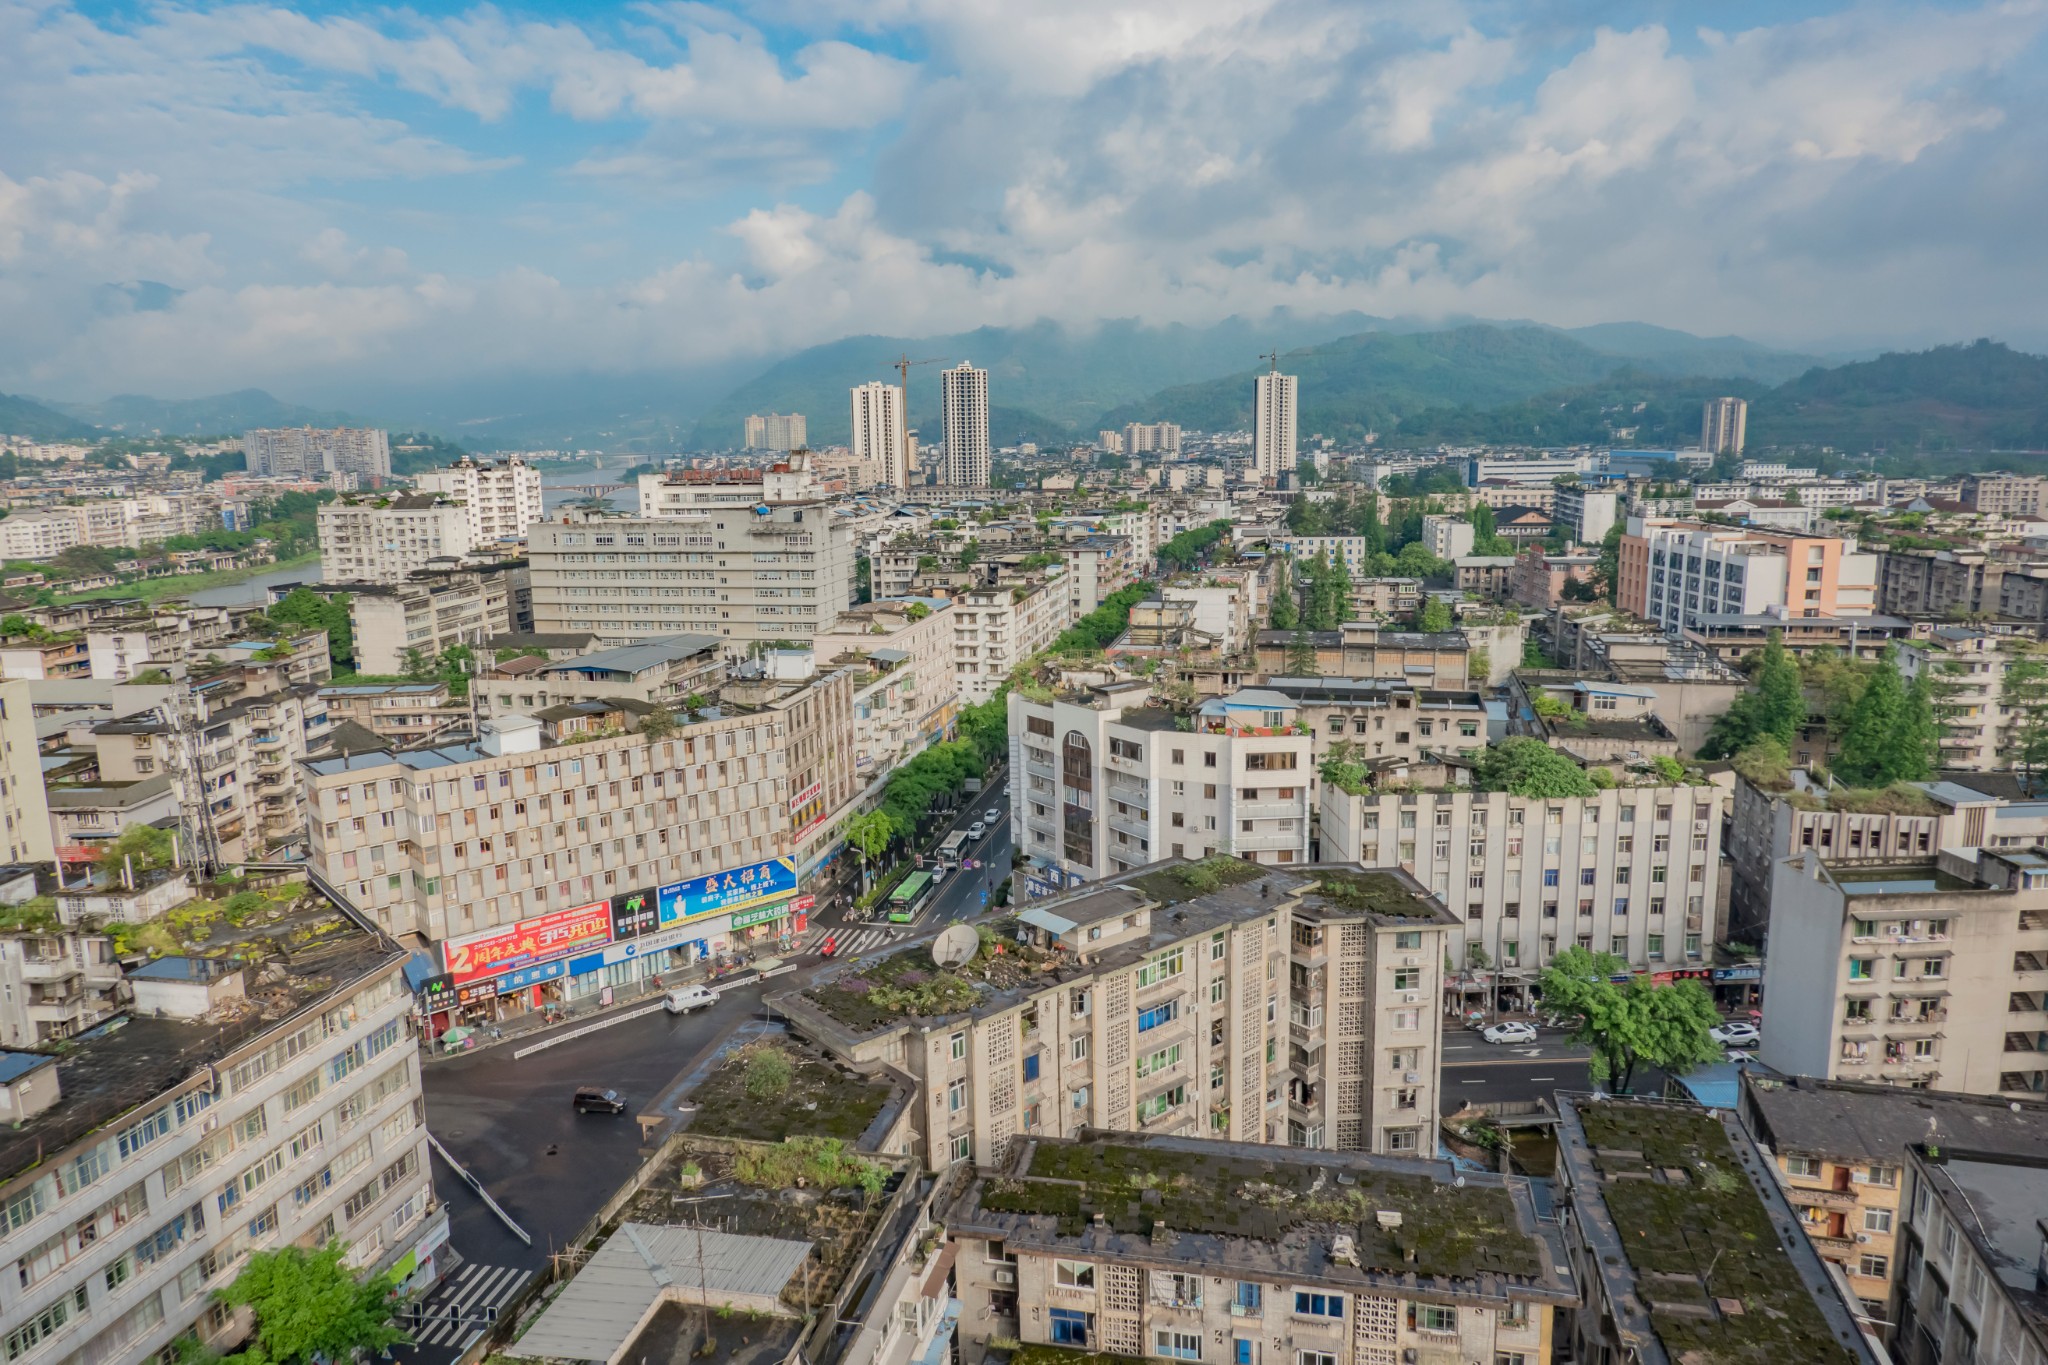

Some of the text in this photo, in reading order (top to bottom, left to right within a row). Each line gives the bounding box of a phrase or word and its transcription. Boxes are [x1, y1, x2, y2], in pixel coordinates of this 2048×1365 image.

[705, 864, 771, 894] 盛大招商
[497, 965, 557, 988] 美的照明
